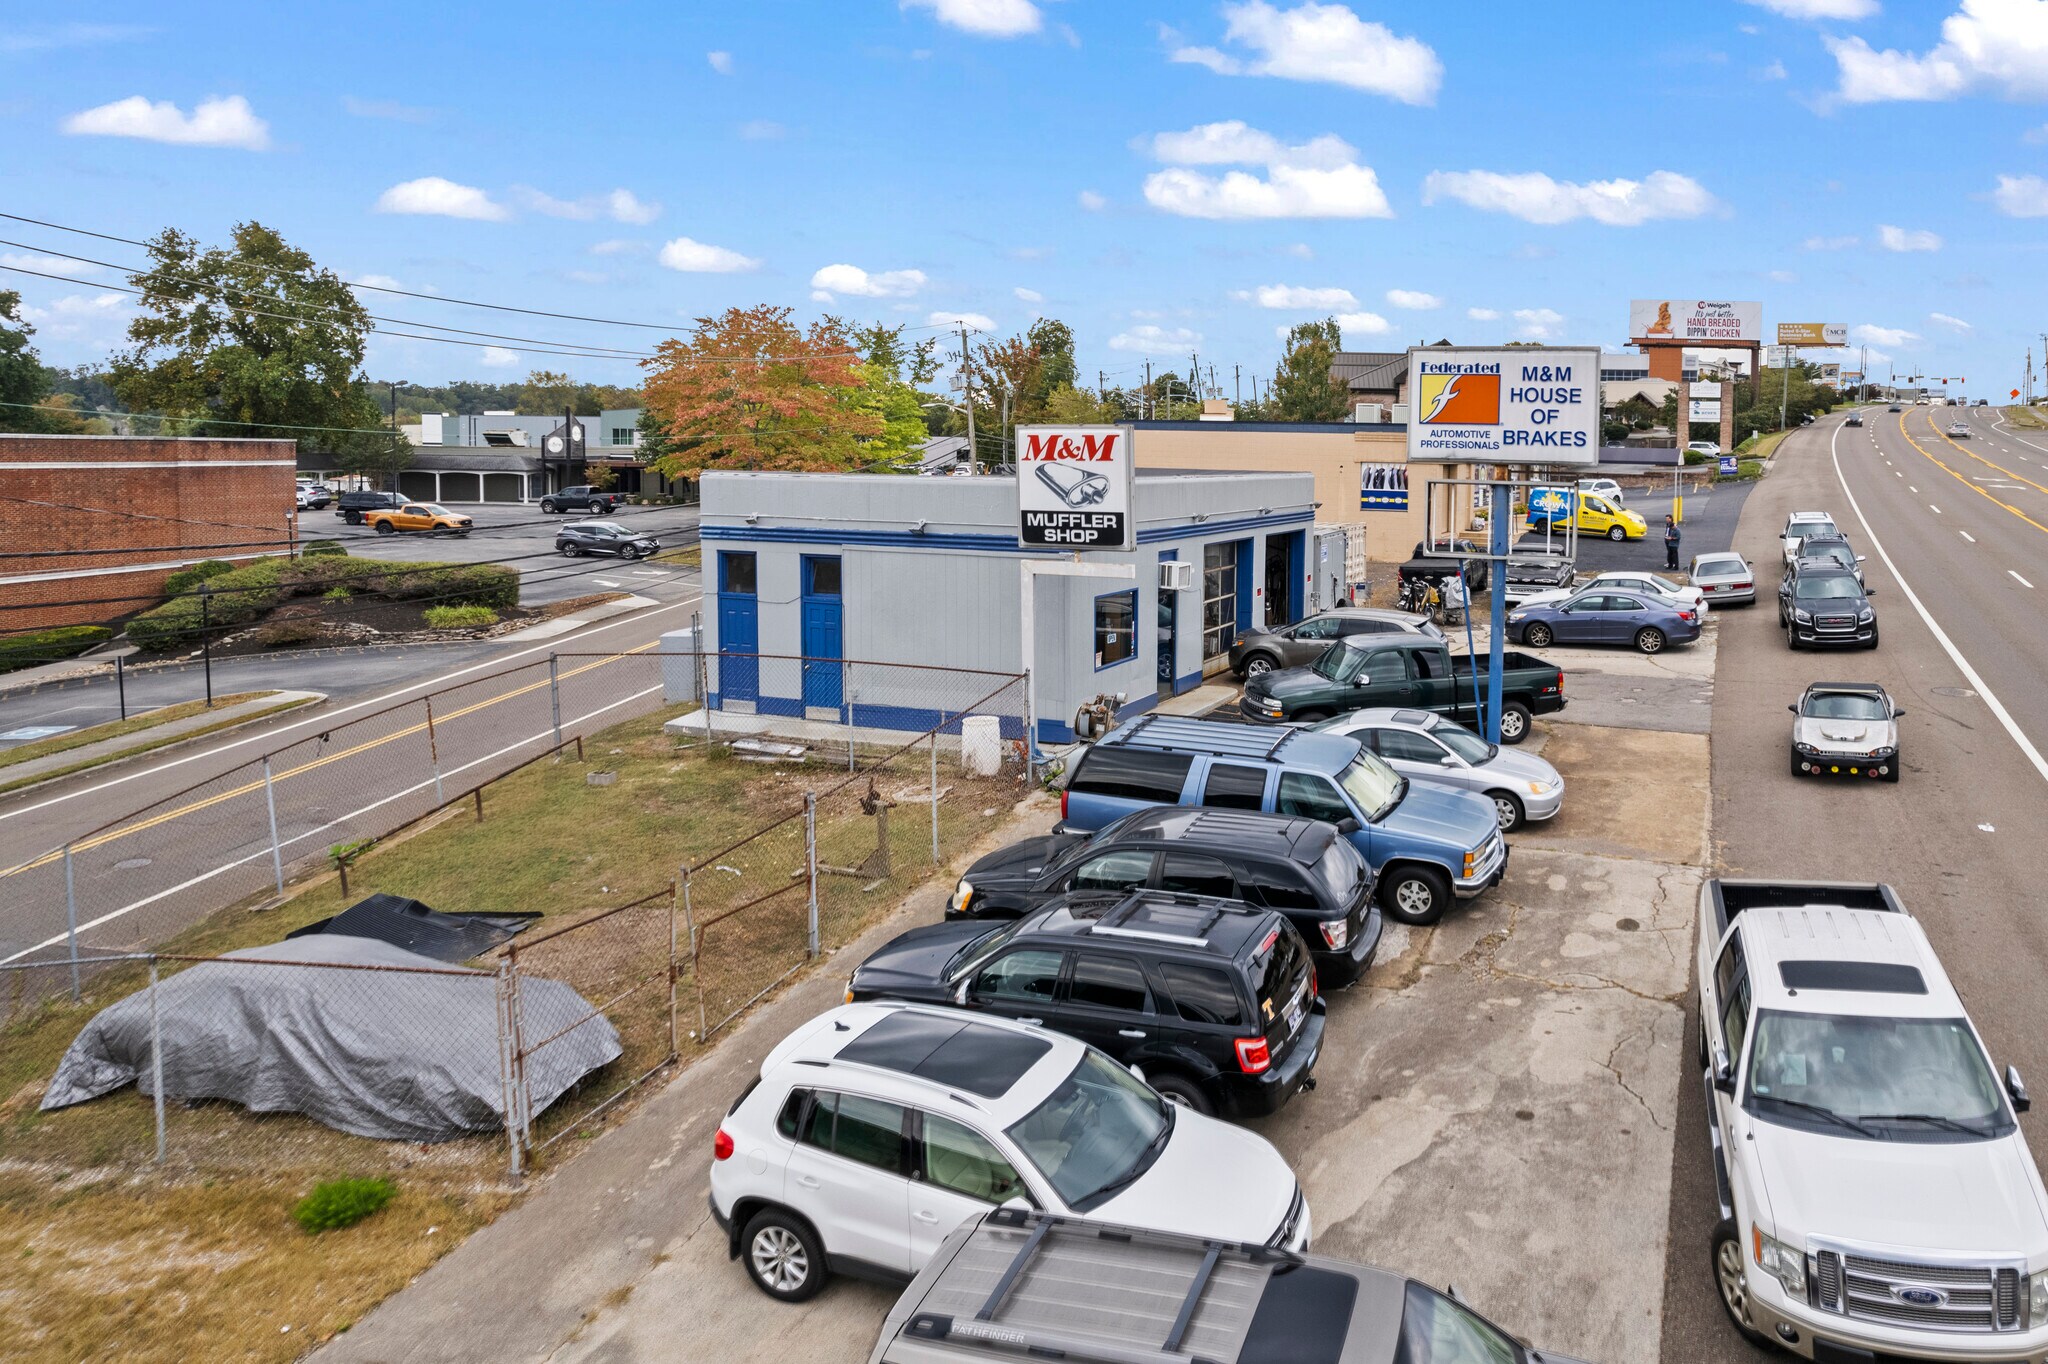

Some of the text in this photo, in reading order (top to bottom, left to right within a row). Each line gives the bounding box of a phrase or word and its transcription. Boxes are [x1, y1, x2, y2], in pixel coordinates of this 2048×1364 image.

[1705, 310, 1716, 318] just
[1687, 318, 1740, 328] HAND BREADED
[1687, 327, 1740, 338] DIPPIN' CHICKEN
[1420, 362, 1500, 374] Federated
[1522, 366, 1572, 382] M&M
[1510, 388, 1582, 404] HOUSE
[1530, 408, 1560, 424] OF
[1430, 430, 1491, 439] AUTOMOTIVE
[1502, 430, 1587, 447] BRAKES
[1022, 434, 1120, 462] M&M
[1420, 440, 1500, 450] PROFESSIONALS
[1533, 500, 1568, 509] CROWN
[1026, 513, 1117, 528] MUFFLER
[1044, 529, 1098, 542] SHOP
[951, 1325, 1025, 1344] PATHFINDER
